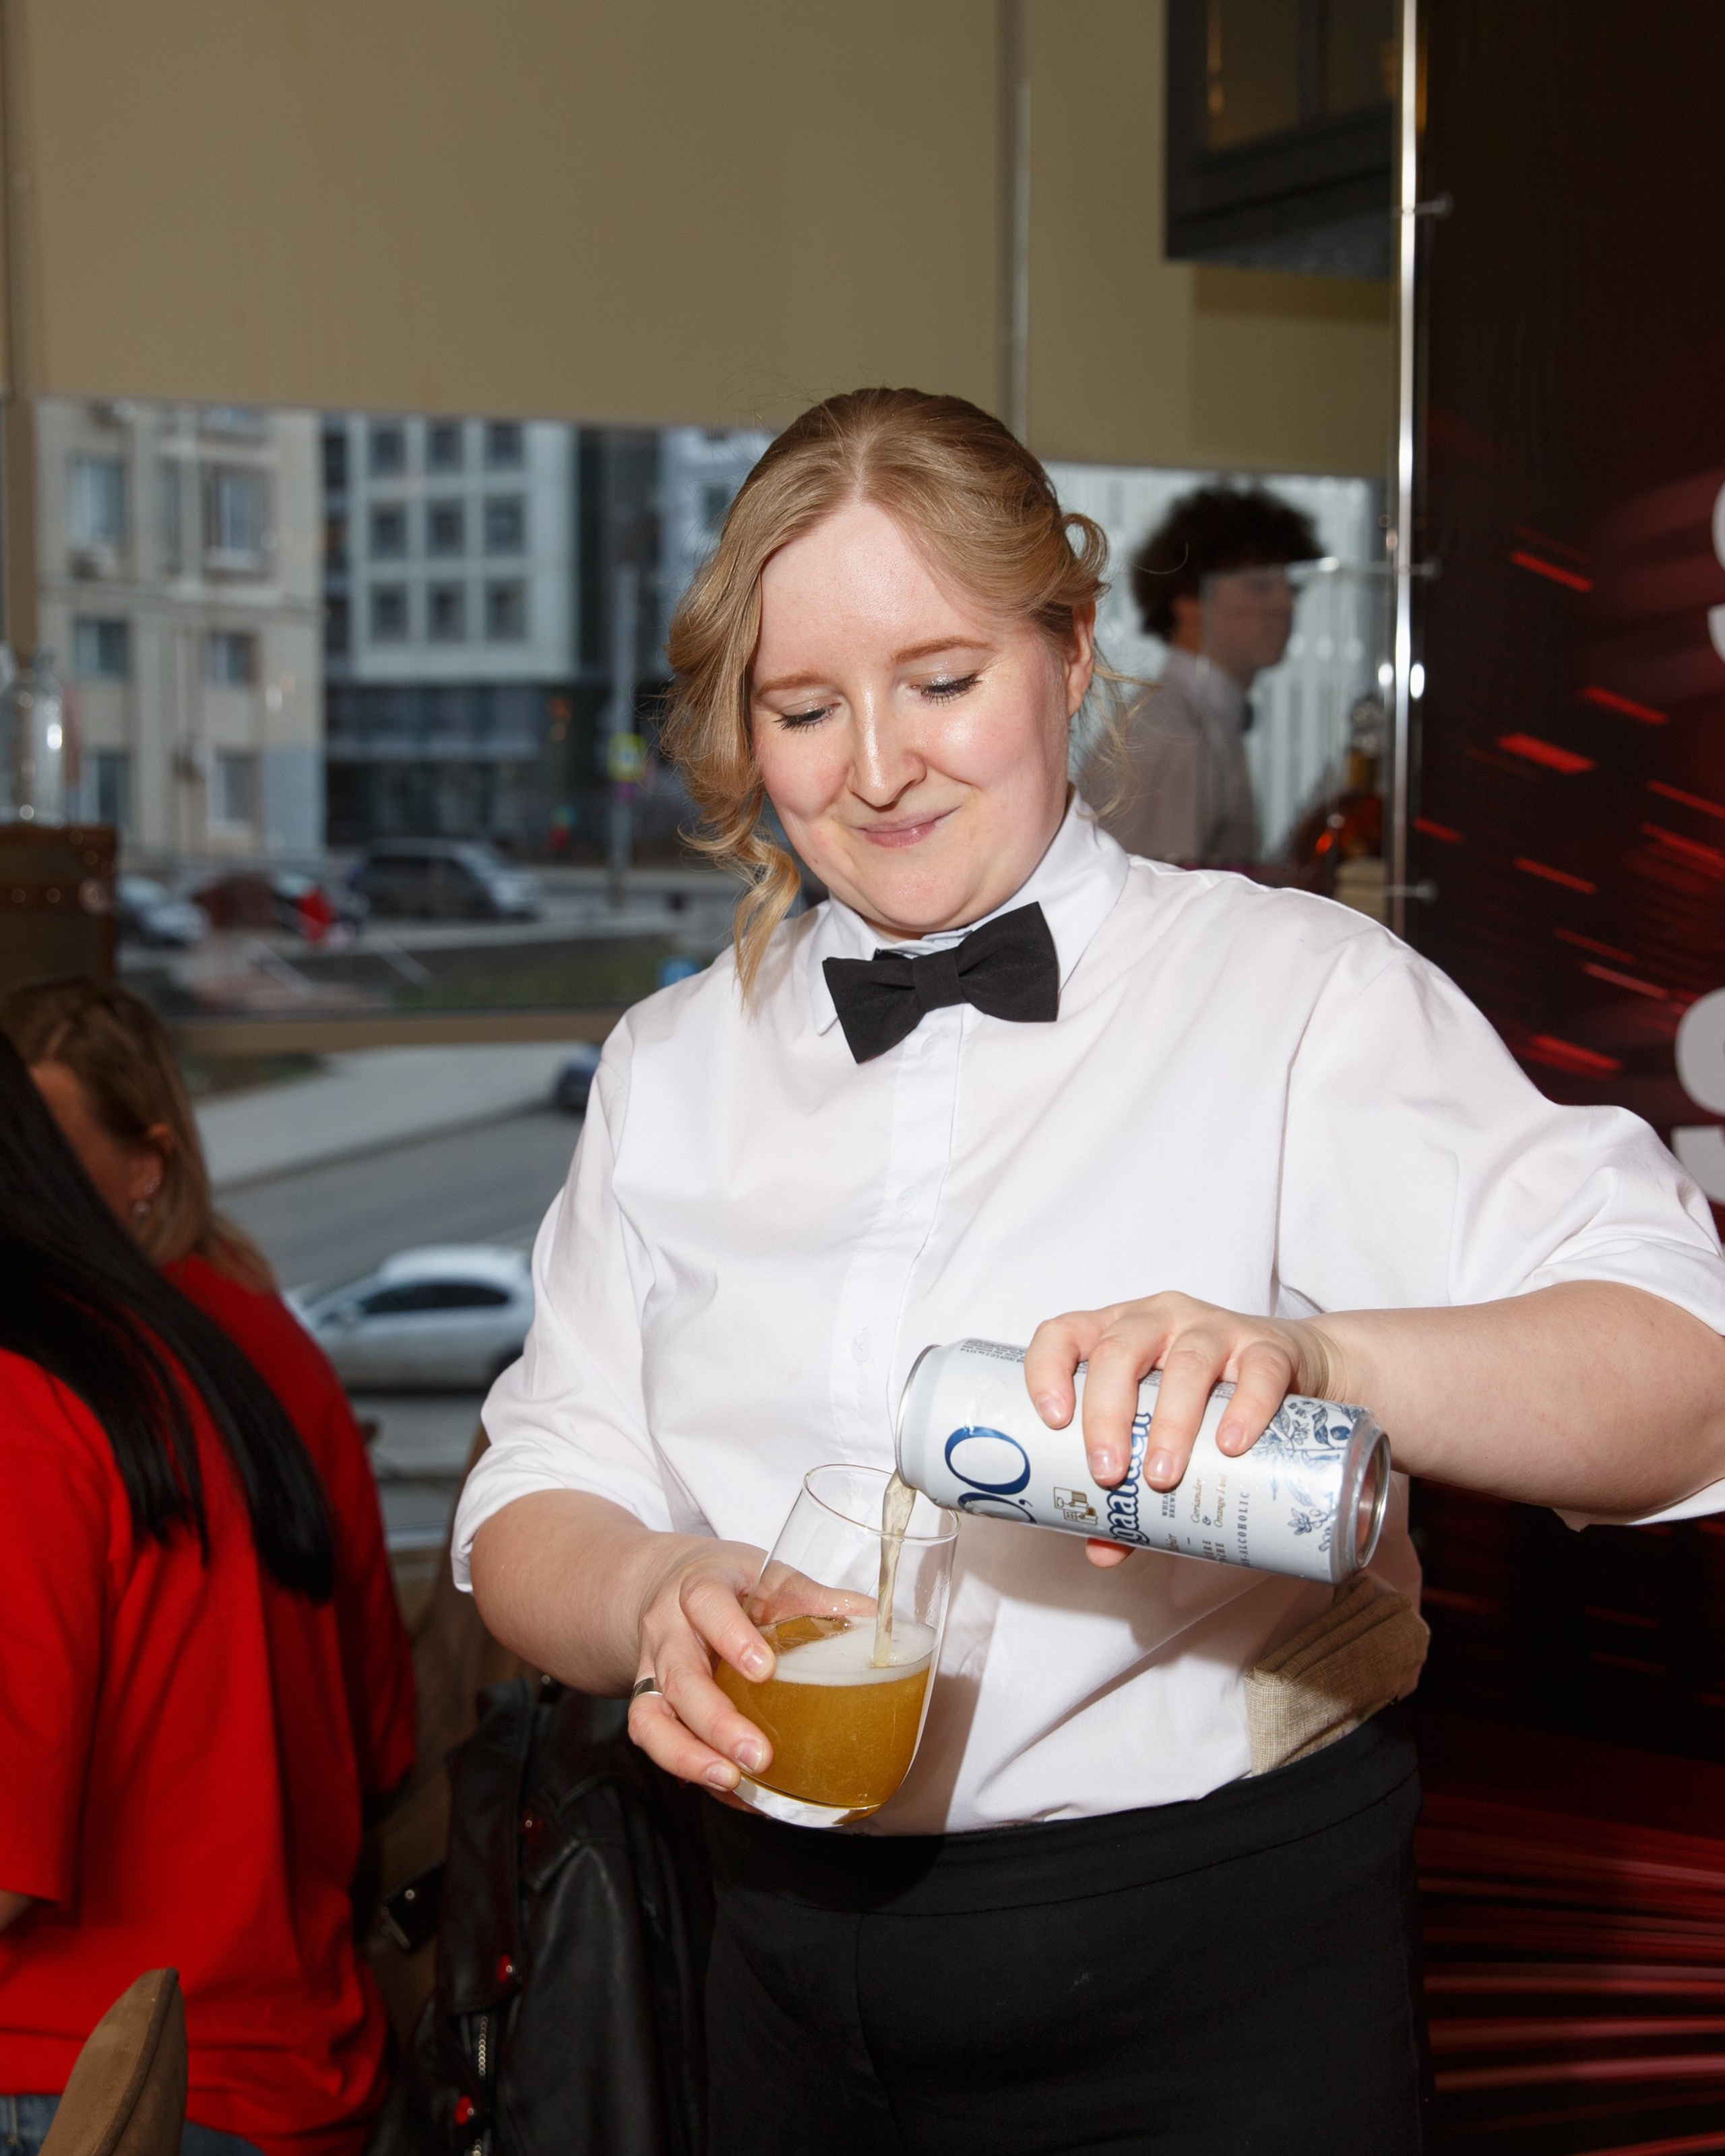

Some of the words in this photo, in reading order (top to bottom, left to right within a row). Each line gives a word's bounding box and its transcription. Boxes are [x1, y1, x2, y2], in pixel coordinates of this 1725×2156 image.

[1191, 1478, 1203, 1523] Coriander
[1214, 1496, 1226, 1528] Orange
[1202, 1515, 1212, 1526] &
